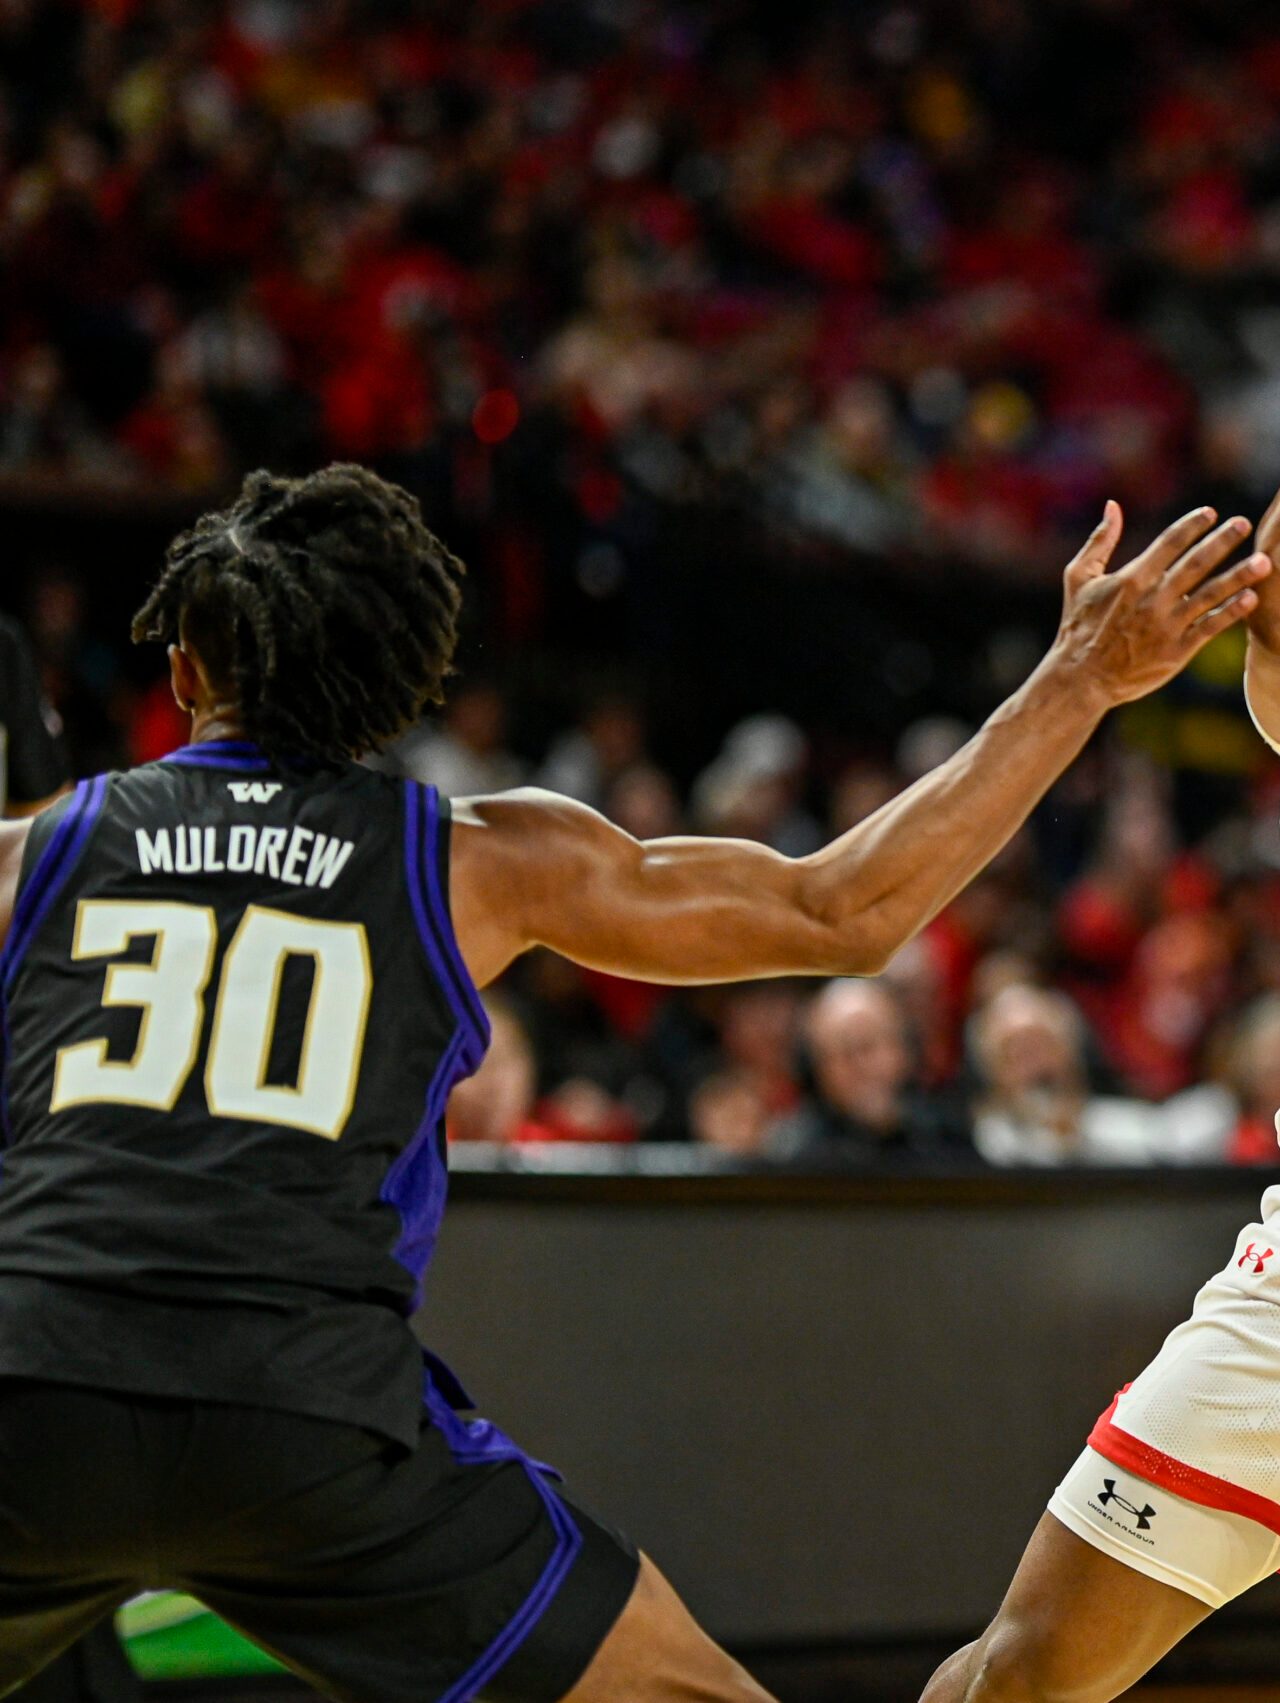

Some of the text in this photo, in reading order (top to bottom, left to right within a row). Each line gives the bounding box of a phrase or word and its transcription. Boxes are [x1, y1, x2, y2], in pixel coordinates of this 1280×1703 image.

[227, 782, 282, 804] W
[135, 824, 355, 889] MULDREW
[48, 900, 373, 1141] 30
[1087, 1500, 1155, 1546] UNDER ARMOUR
